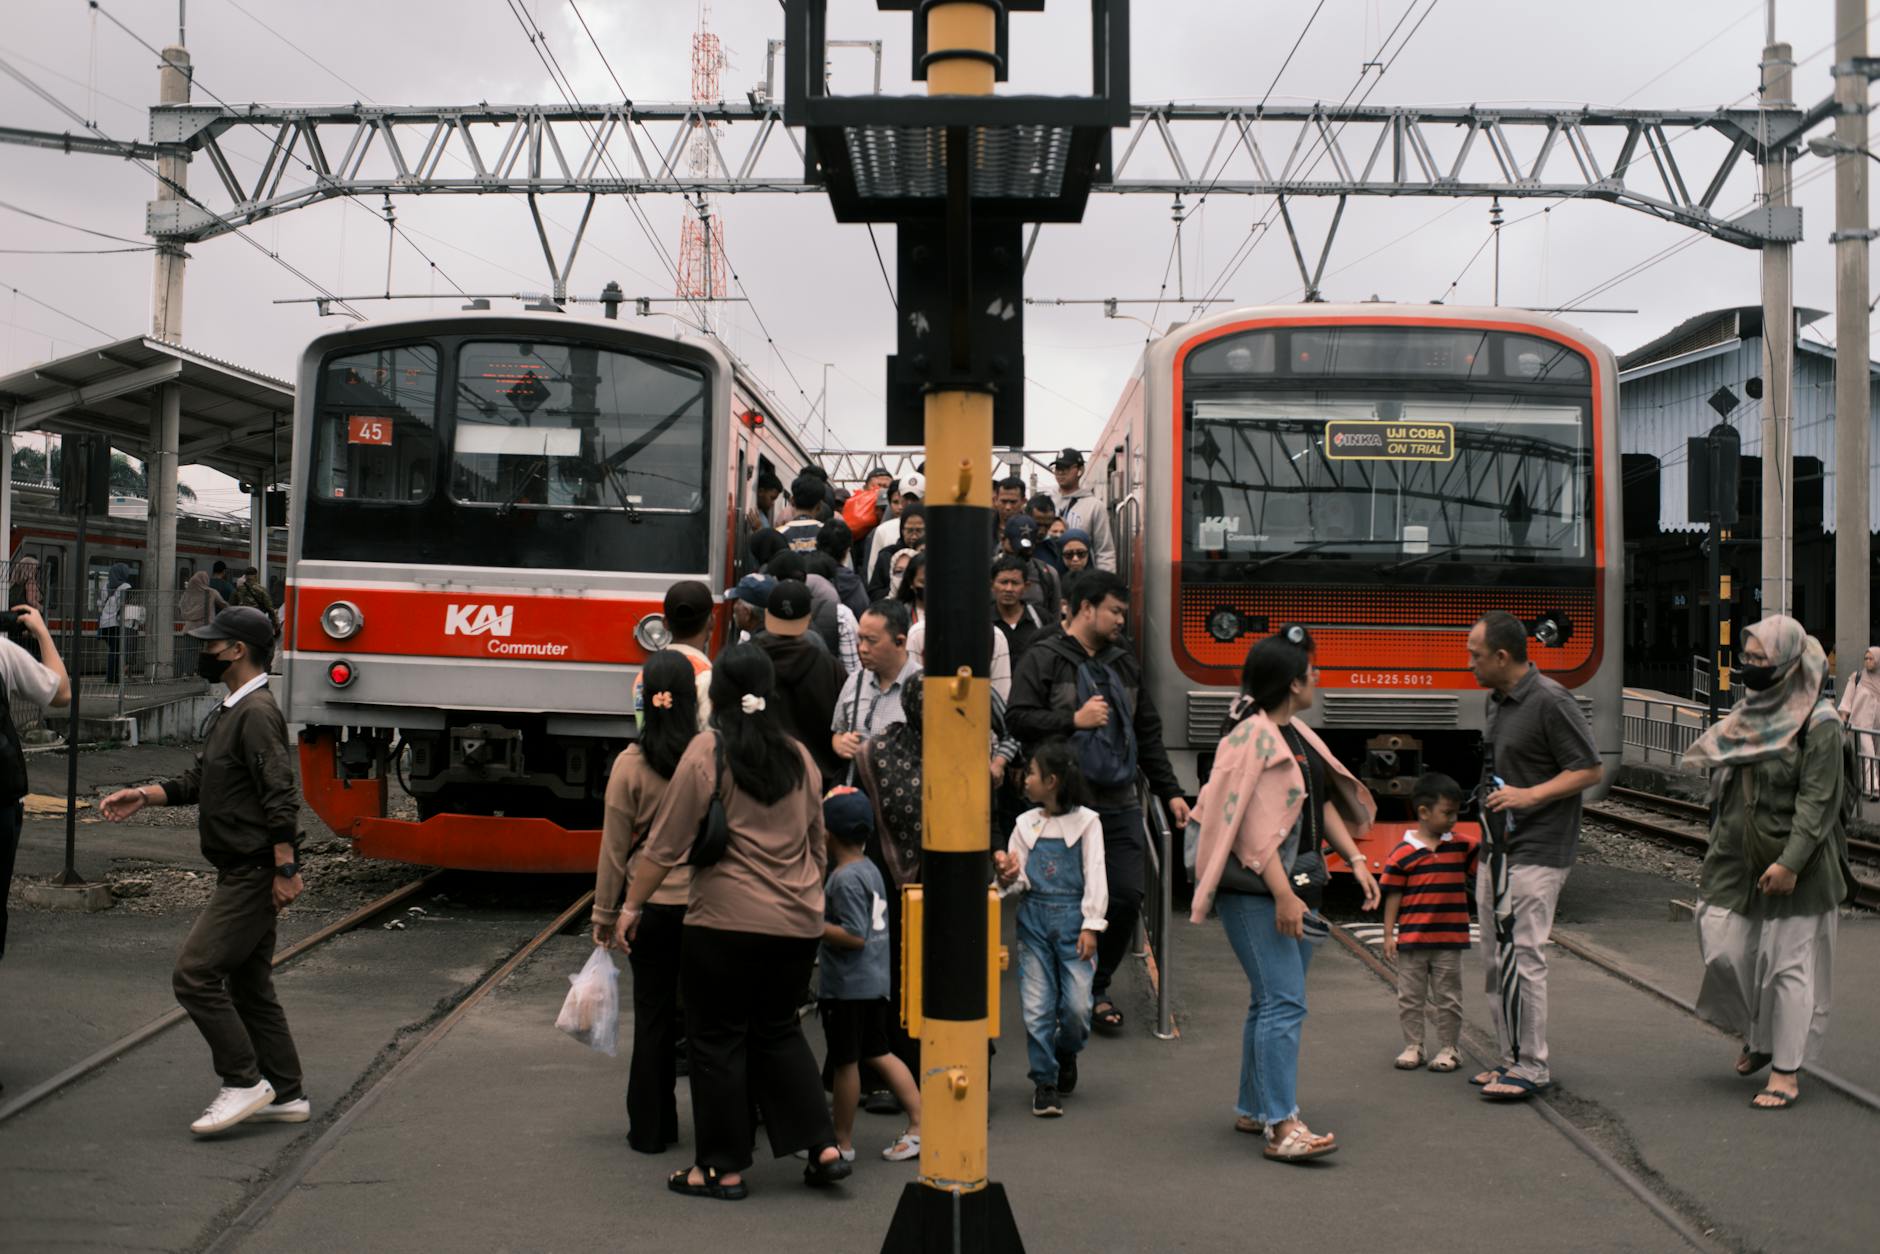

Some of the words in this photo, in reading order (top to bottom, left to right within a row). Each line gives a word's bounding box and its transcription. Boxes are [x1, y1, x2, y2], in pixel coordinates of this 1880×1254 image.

[360, 423, 382, 440] 45
[1386, 428, 1406, 438] UJI
[1409, 429, 1446, 439] COBA
[1344, 434, 1382, 446] INKA
[1387, 443, 1407, 454] ON
[1410, 444, 1444, 455] TRIAL
[1227, 533, 1269, 541] Commuter
[444, 604, 514, 636] KAI
[488, 639, 568, 655] Commuter
